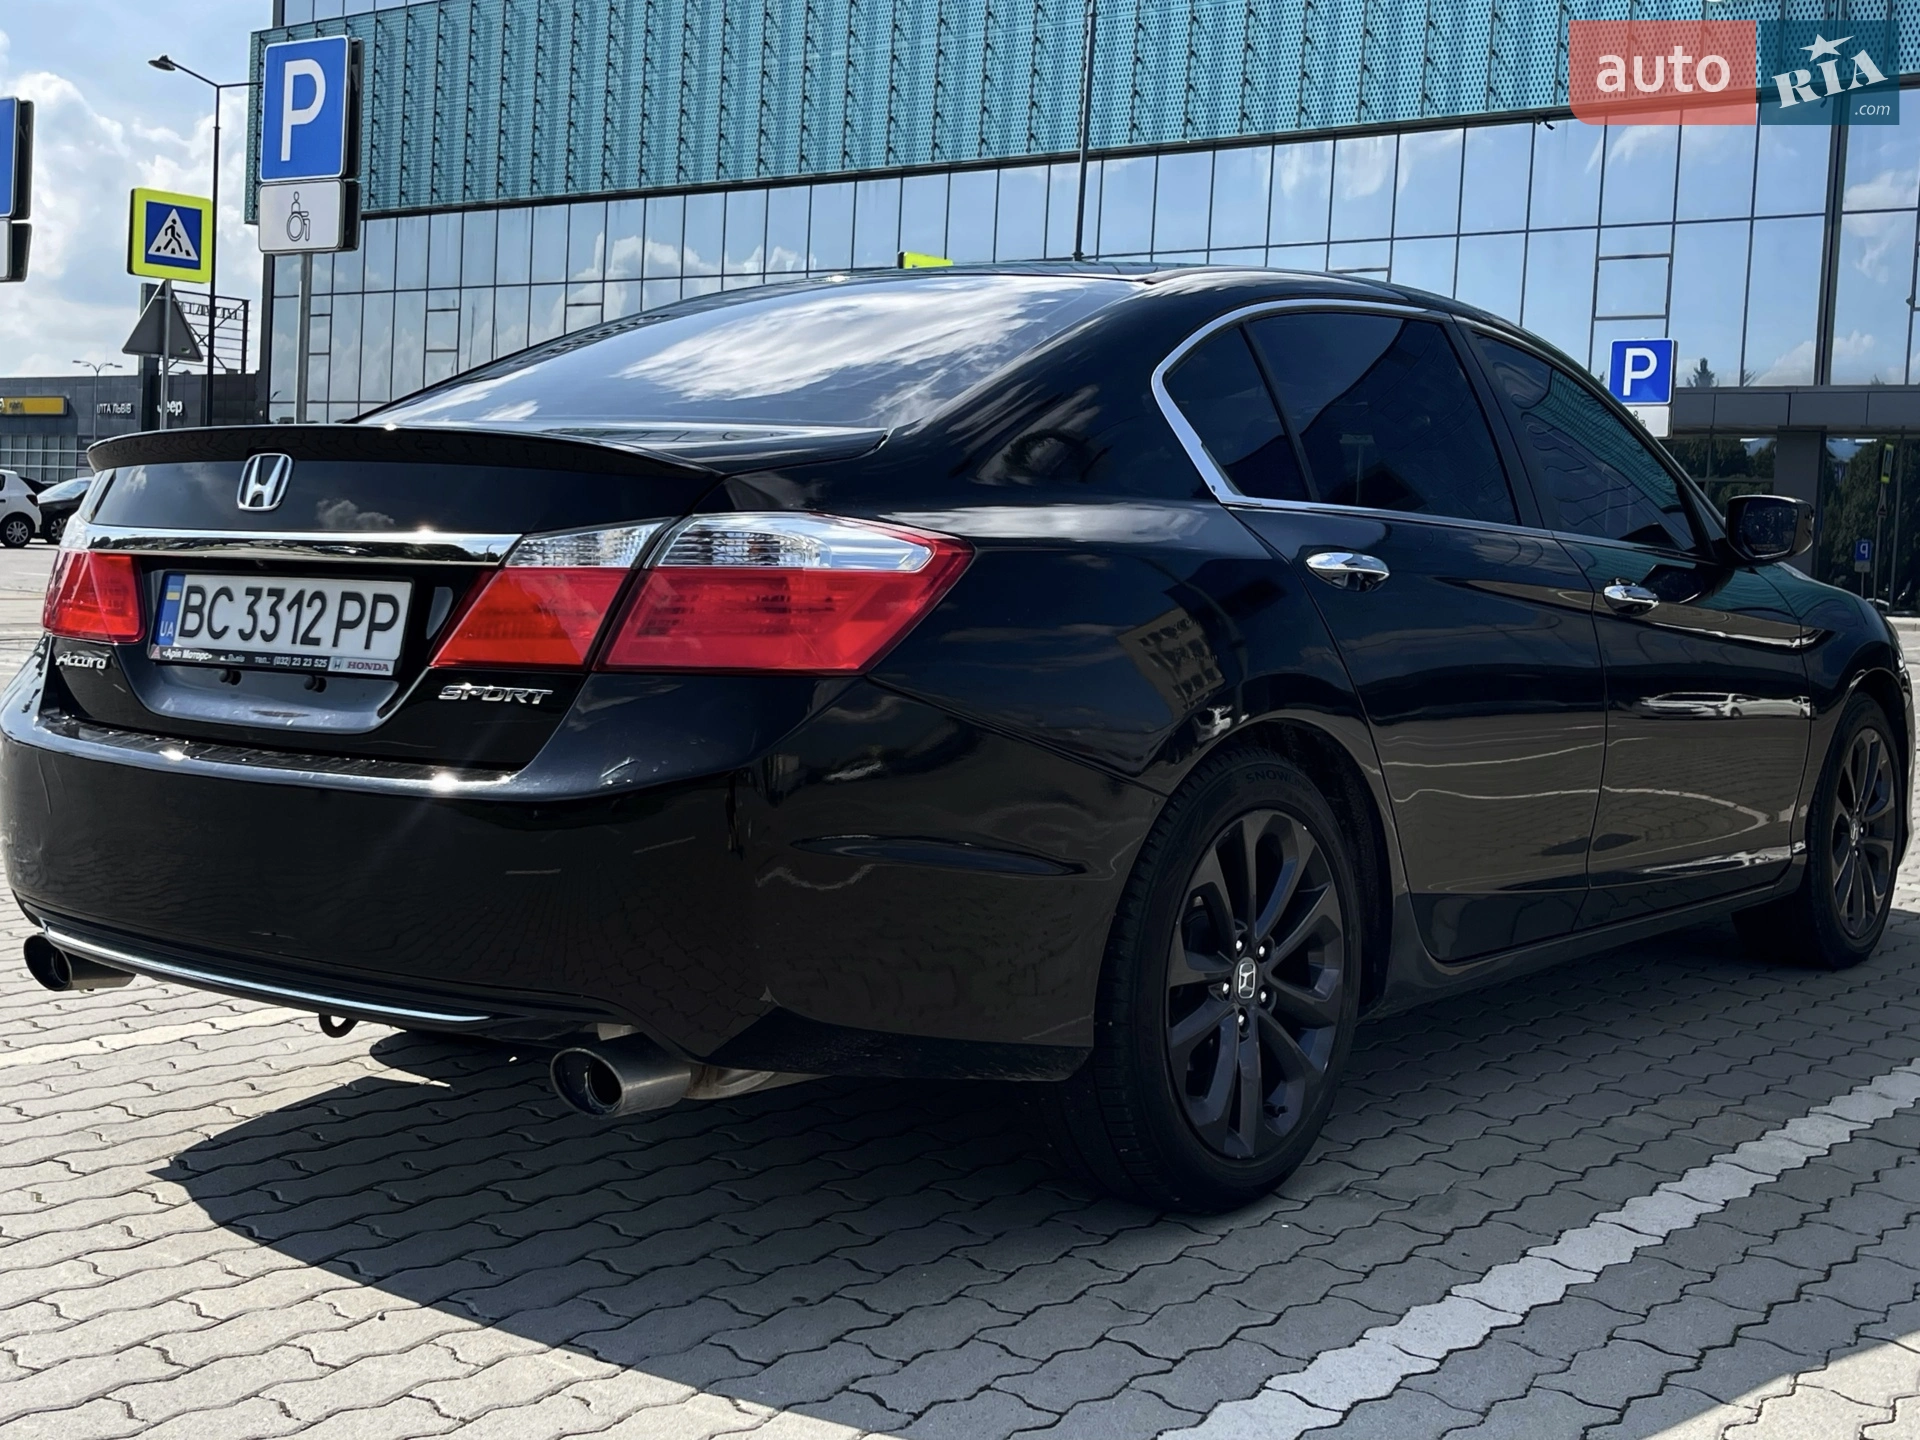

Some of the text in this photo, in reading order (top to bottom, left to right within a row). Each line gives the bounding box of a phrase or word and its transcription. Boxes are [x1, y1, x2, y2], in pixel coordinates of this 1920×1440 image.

[280, 58, 327, 162] P
[1622, 347, 1658, 397] P
[160, 621, 174, 637] UA
[237, 586, 327, 646] 3312
[346, 661, 390, 672] HONDA
[438, 682, 554, 704] SPORT
